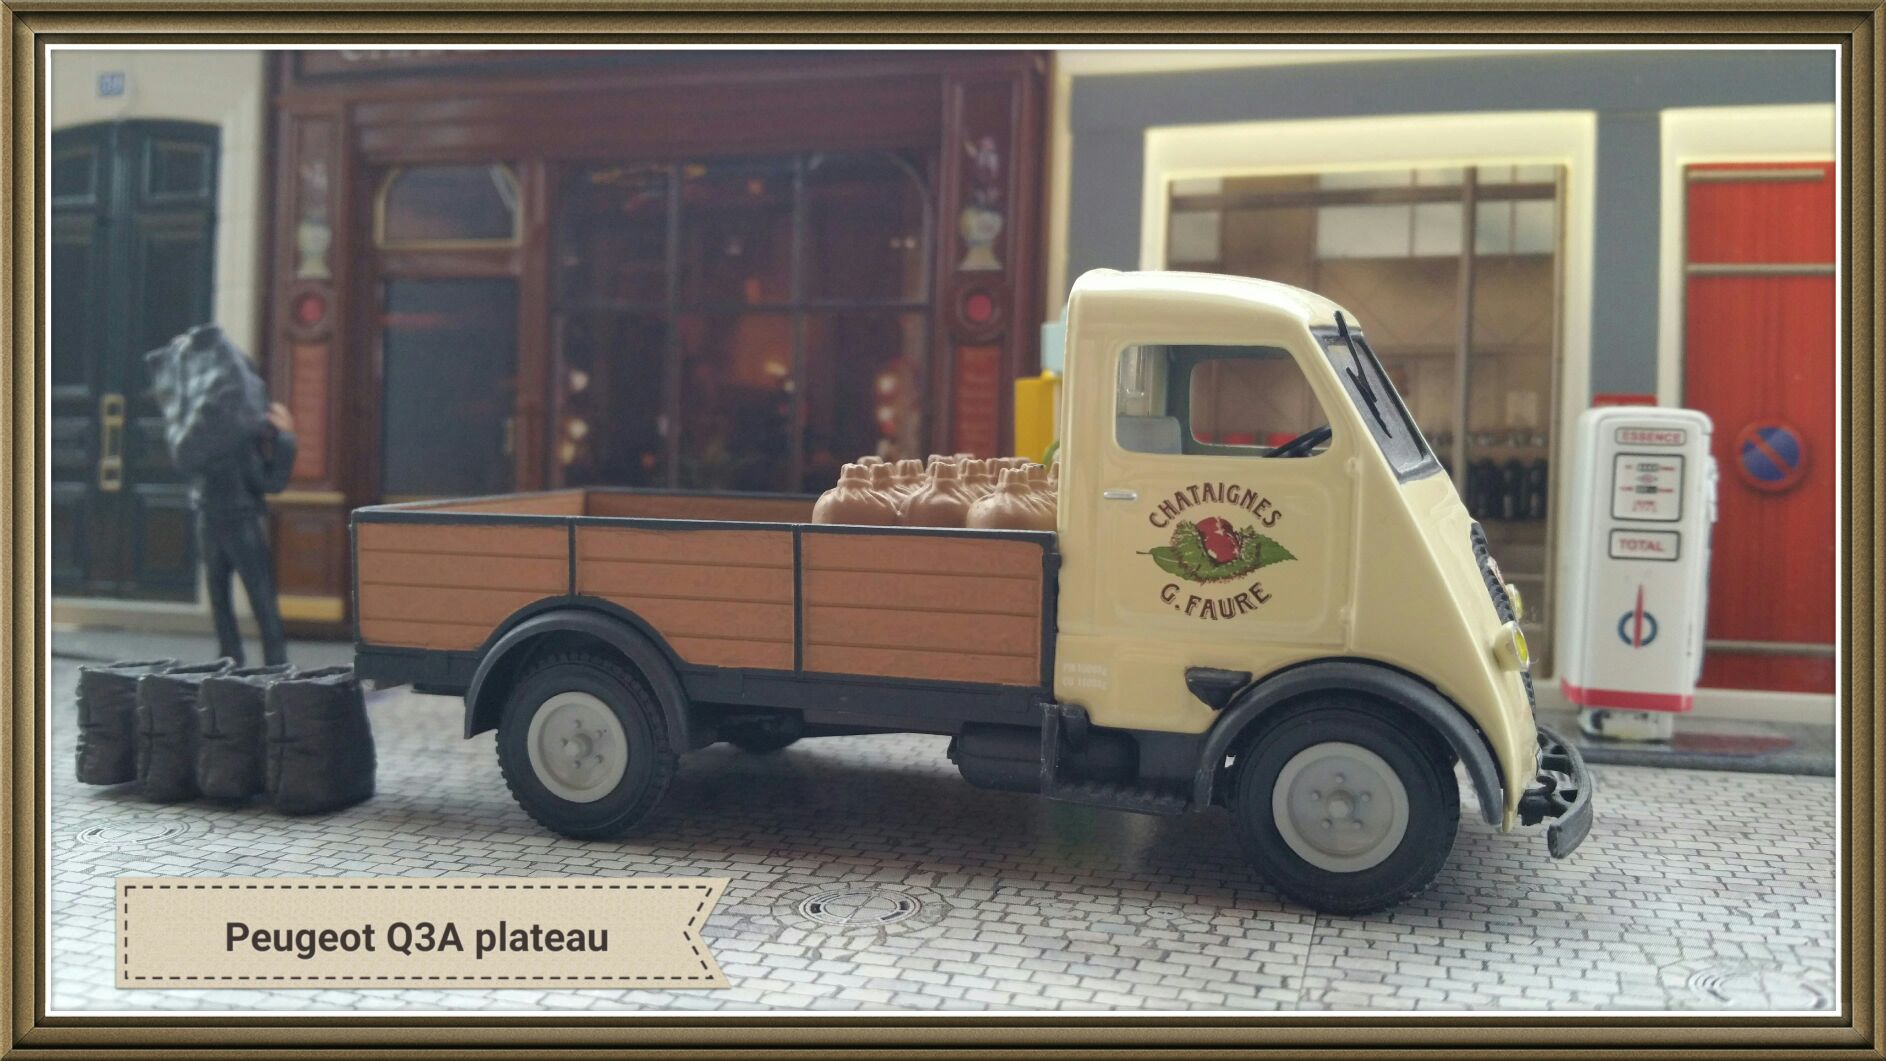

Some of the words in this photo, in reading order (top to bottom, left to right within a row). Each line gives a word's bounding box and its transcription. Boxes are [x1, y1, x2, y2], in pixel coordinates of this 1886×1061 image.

[1621, 431, 1681, 444] ESSENCE
[1148, 482, 1282, 529] CHATAIGNES
[1618, 537, 1665, 552] TOTAL
